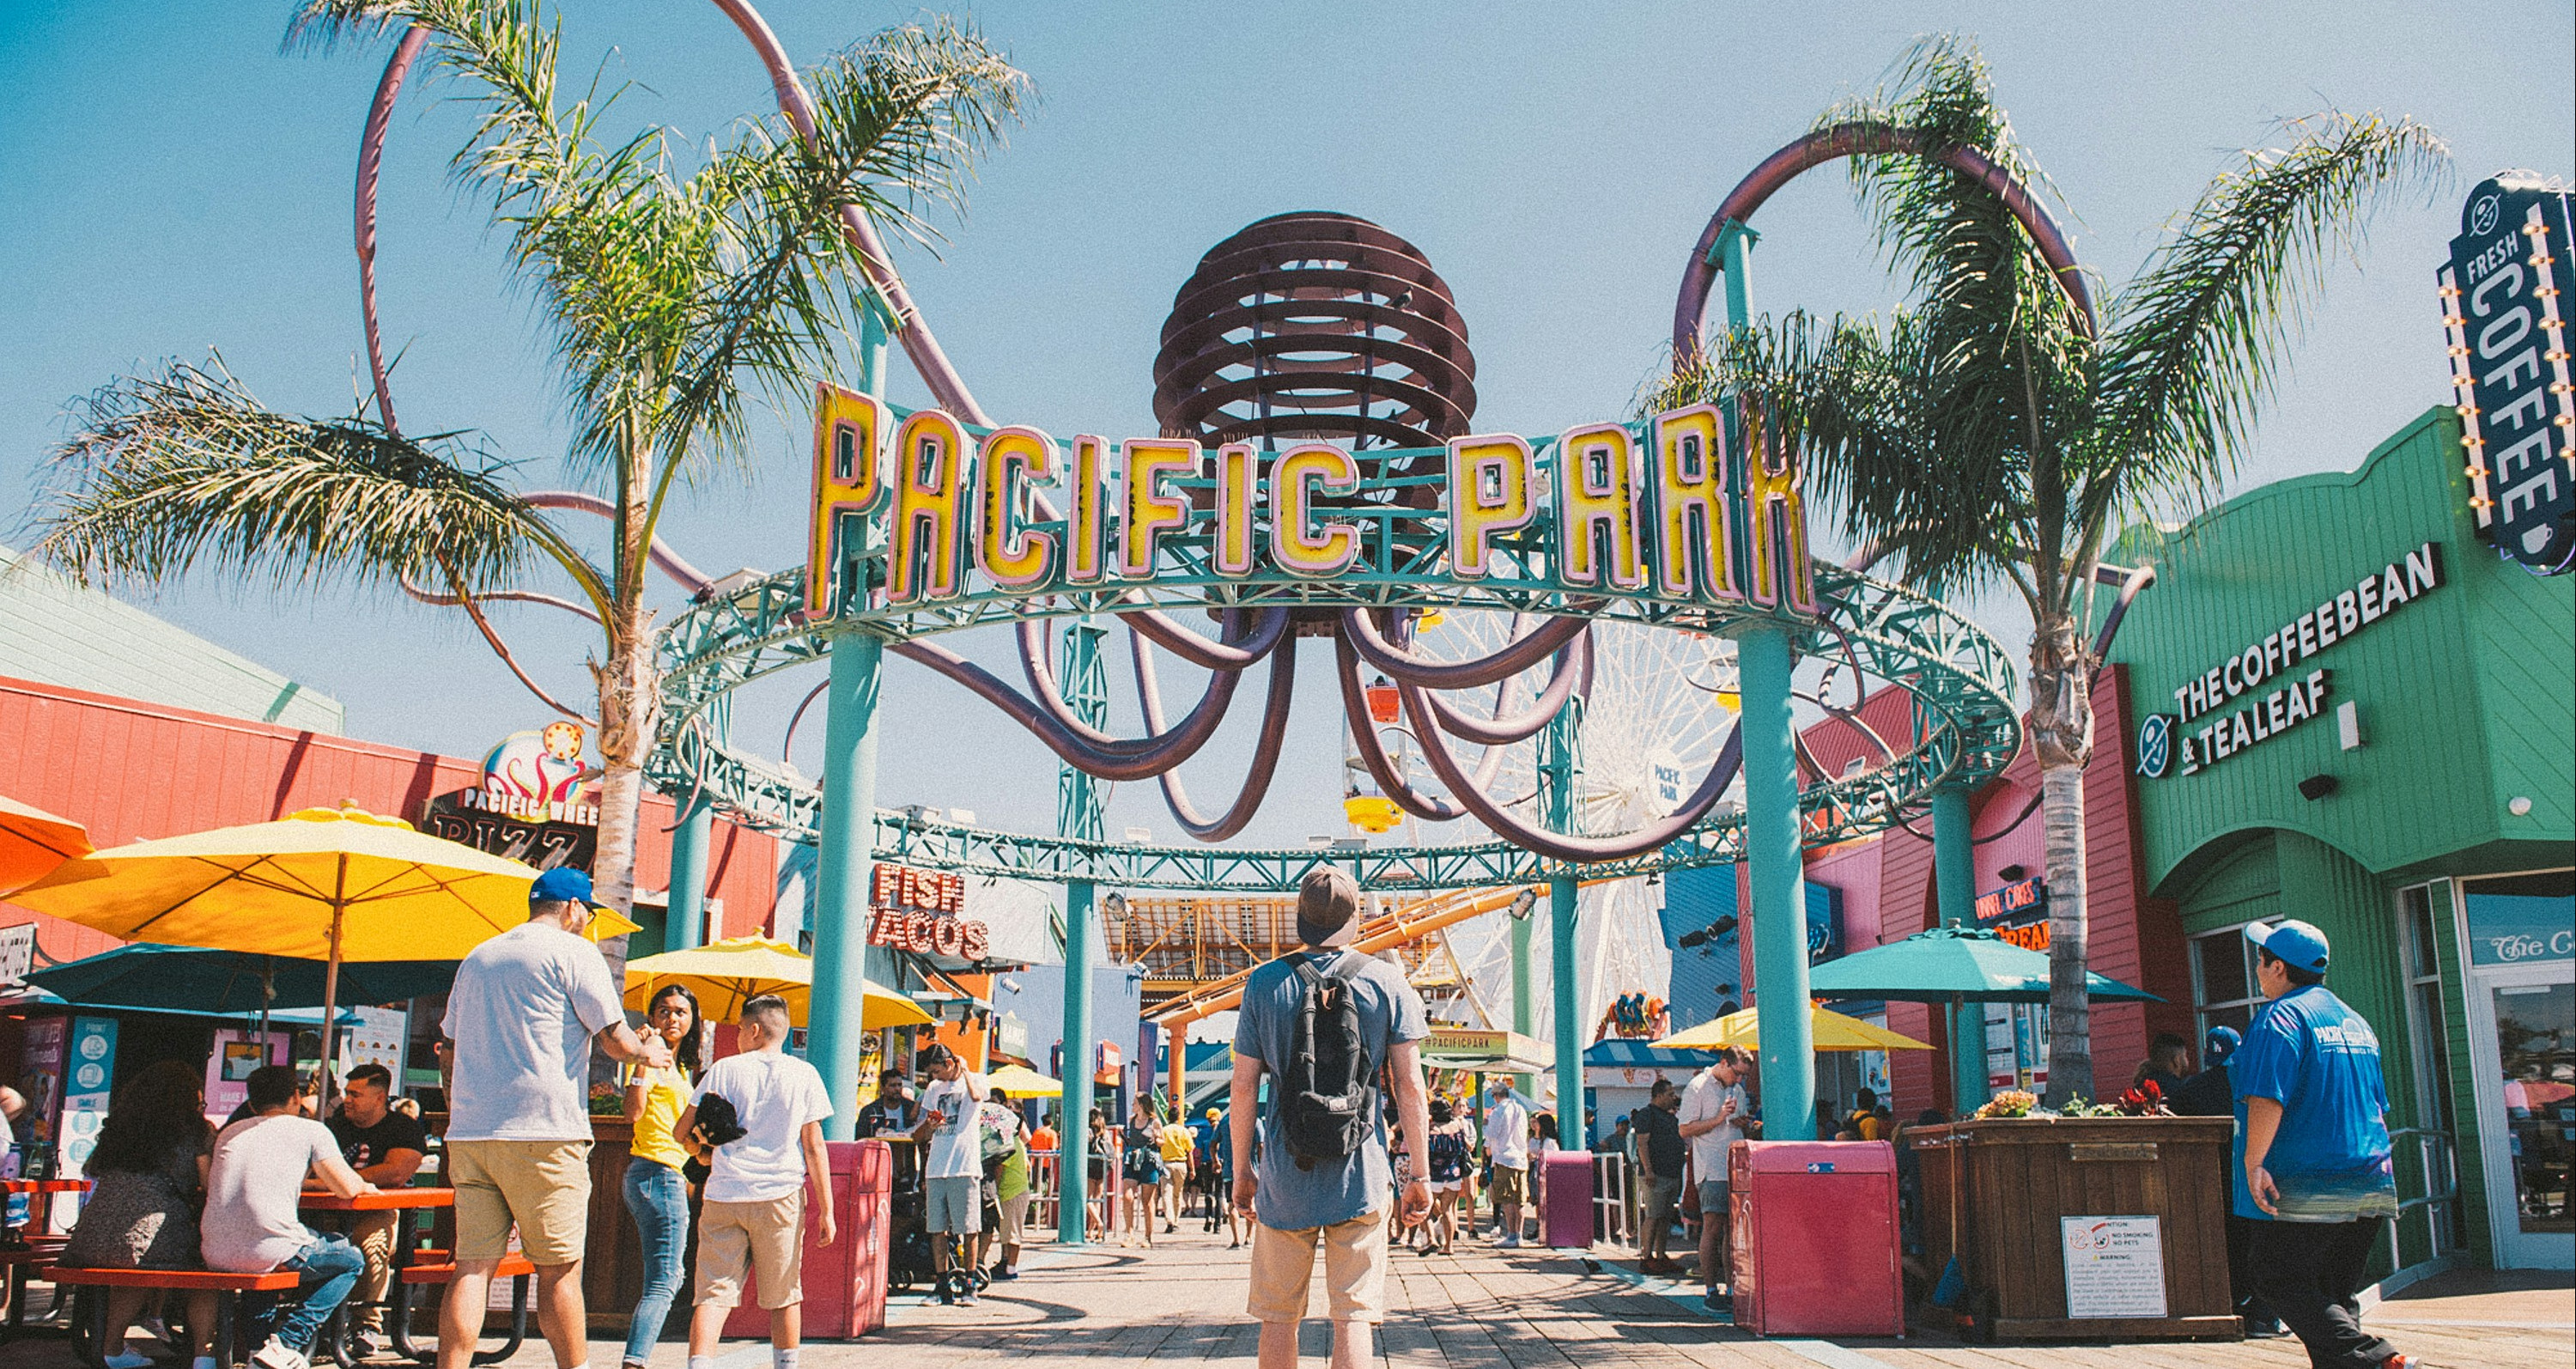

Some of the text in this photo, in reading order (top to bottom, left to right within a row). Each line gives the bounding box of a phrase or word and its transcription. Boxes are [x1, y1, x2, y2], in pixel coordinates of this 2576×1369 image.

[2467, 230, 2519, 284] FRESH
[2471, 262, 2558, 525] COFFEE
[804, 380, 1820, 624] PACIFIC PARK
[2181, 737, 2199, 775] &
[463, 788, 599, 826] PACIFIC WHEE
[434, 813, 592, 871] PIZZ
[875, 862, 965, 912] FISH
[2491, 930, 2575, 961] The C
[1424, 1037, 1490, 1049] #PACIFICPARK
